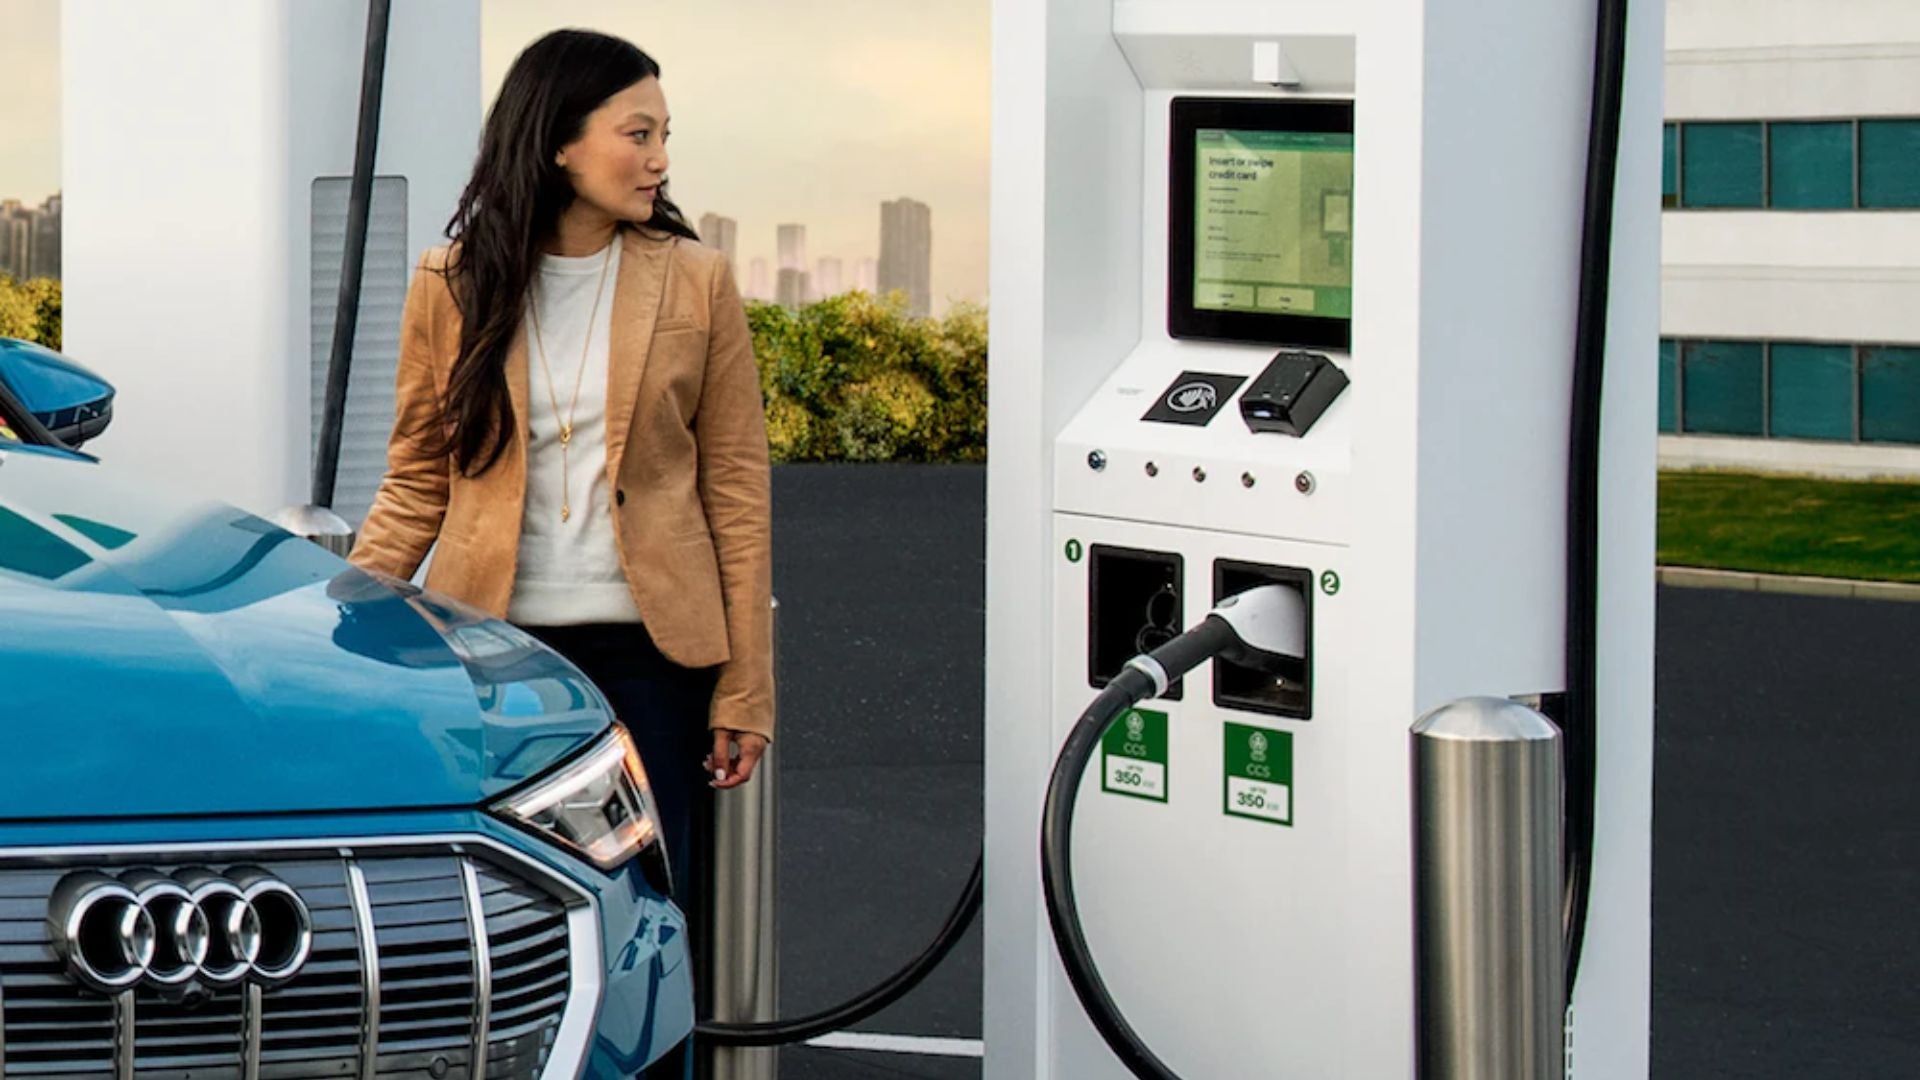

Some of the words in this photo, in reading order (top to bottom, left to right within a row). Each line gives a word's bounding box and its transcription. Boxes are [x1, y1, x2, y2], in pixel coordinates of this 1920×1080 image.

[1208, 170, 1235, 180] credit
[1236, 171, 1257, 181] card
[1324, 574, 1336, 592] 2
[1123, 742, 1147, 757] CCS
[1115, 769, 1141, 786] 350
[1246, 763, 1270, 778] CCS
[1237, 791, 1264, 808] 350
